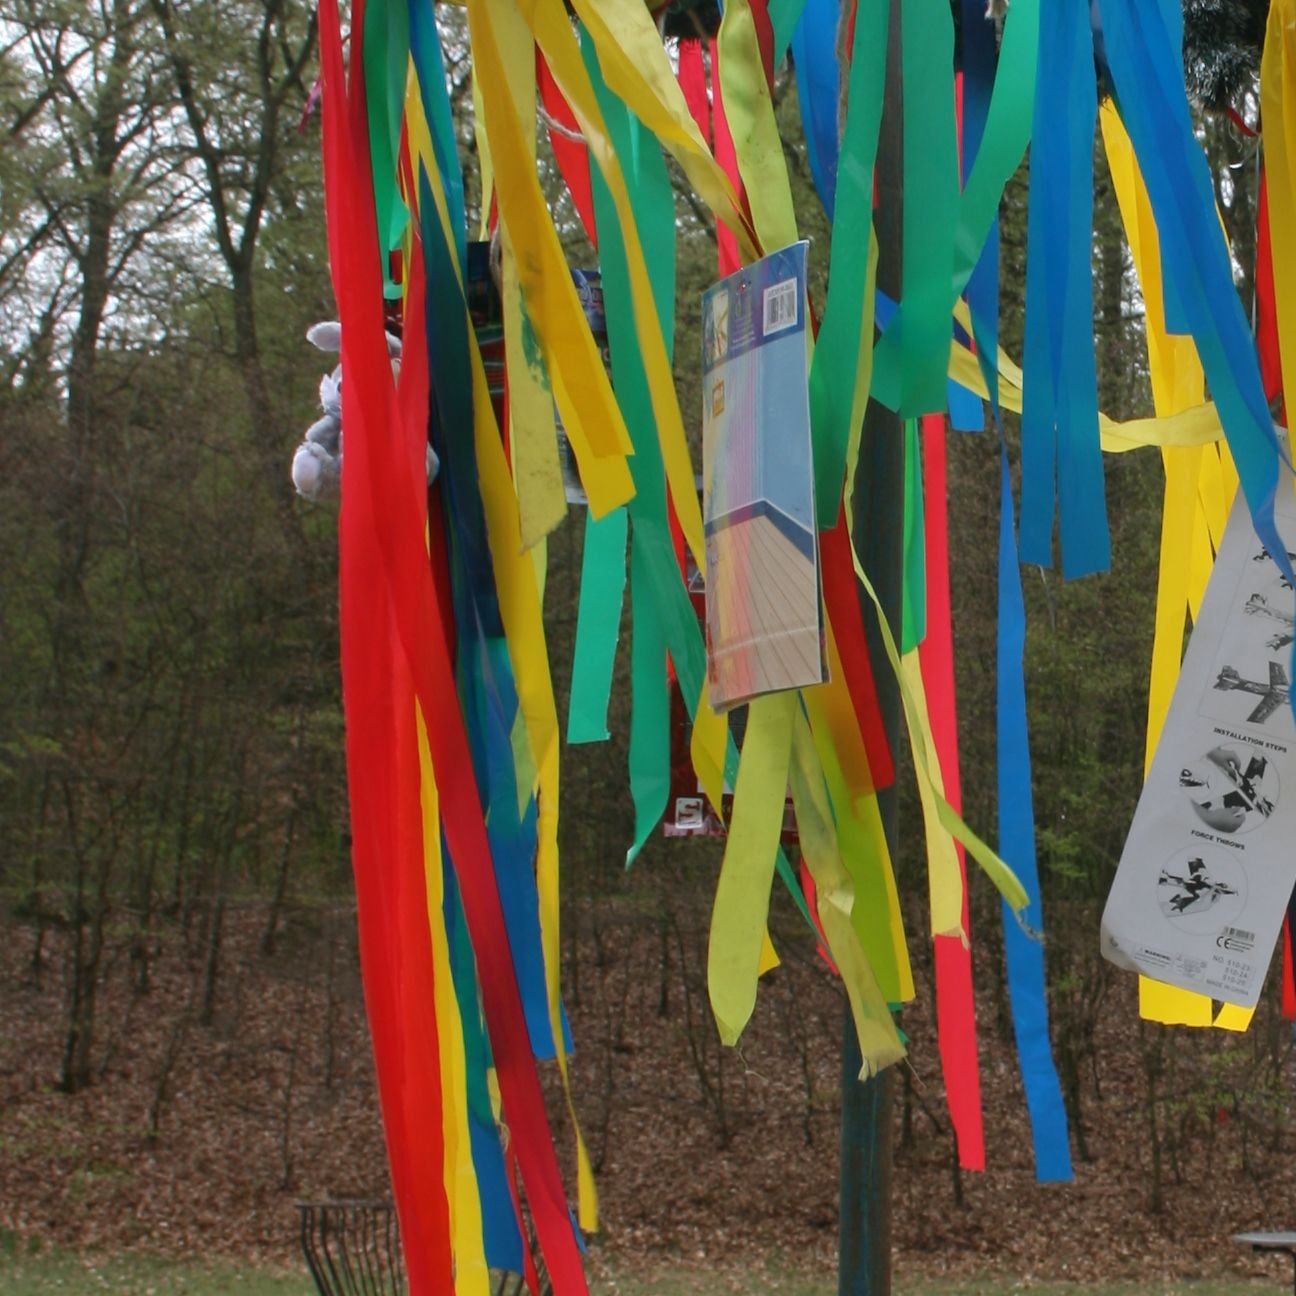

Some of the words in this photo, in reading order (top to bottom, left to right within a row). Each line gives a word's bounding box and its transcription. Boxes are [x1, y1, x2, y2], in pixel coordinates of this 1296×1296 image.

[1213, 727, 1264, 747] INSTALLATION
[1265, 741, 1288, 753] STEPS
[1190, 830, 1214, 841] FORCE
[1216, 837, 1246, 850] THROWS
